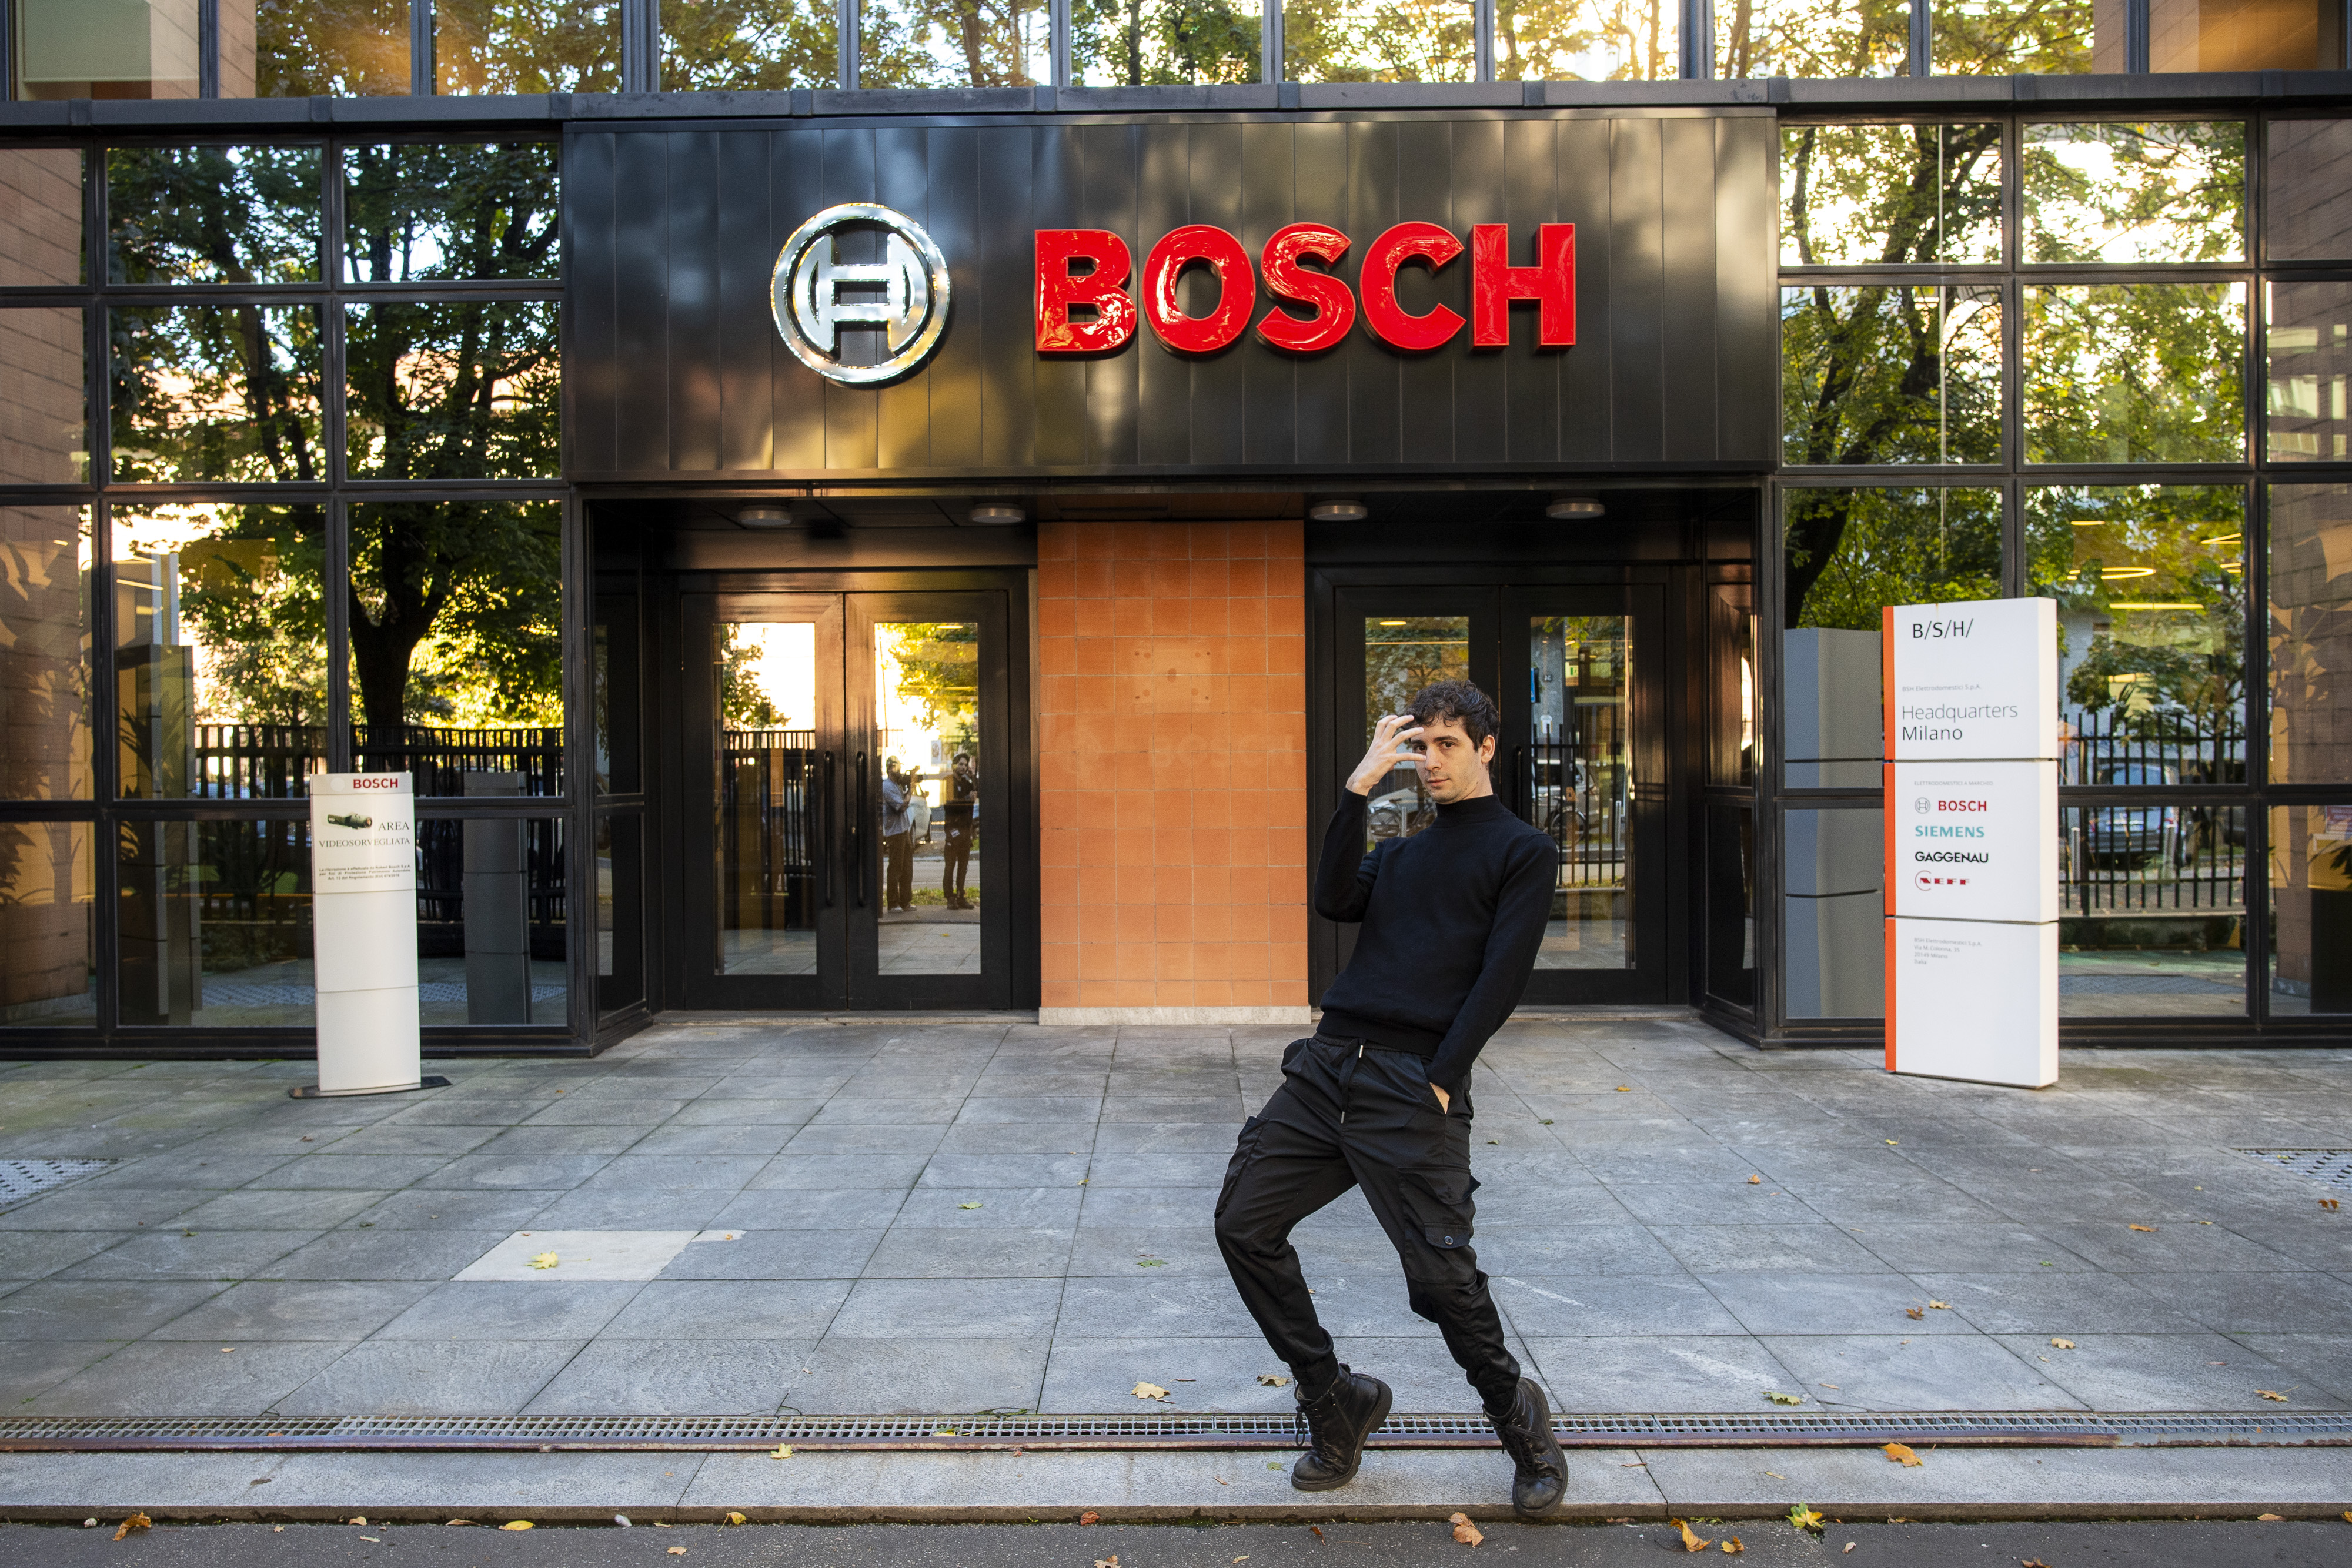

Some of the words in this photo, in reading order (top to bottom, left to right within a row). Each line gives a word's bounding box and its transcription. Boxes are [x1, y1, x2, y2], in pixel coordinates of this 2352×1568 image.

[1035, 221, 1576, 353] BOSCH
[1902, 703, 2019, 723] Headquarters
[1903, 725, 1963, 741] Milano
[353, 778, 399, 789] BOSCH
[1938, 800, 1987, 812] BOSCH
[378, 821, 410, 831] AREA
[1915, 825, 1985, 838] SIEMENS
[319, 837, 410, 848] VIDEOSORVEGLIATA
[1915, 851, 1989, 863] GAGGENAU
